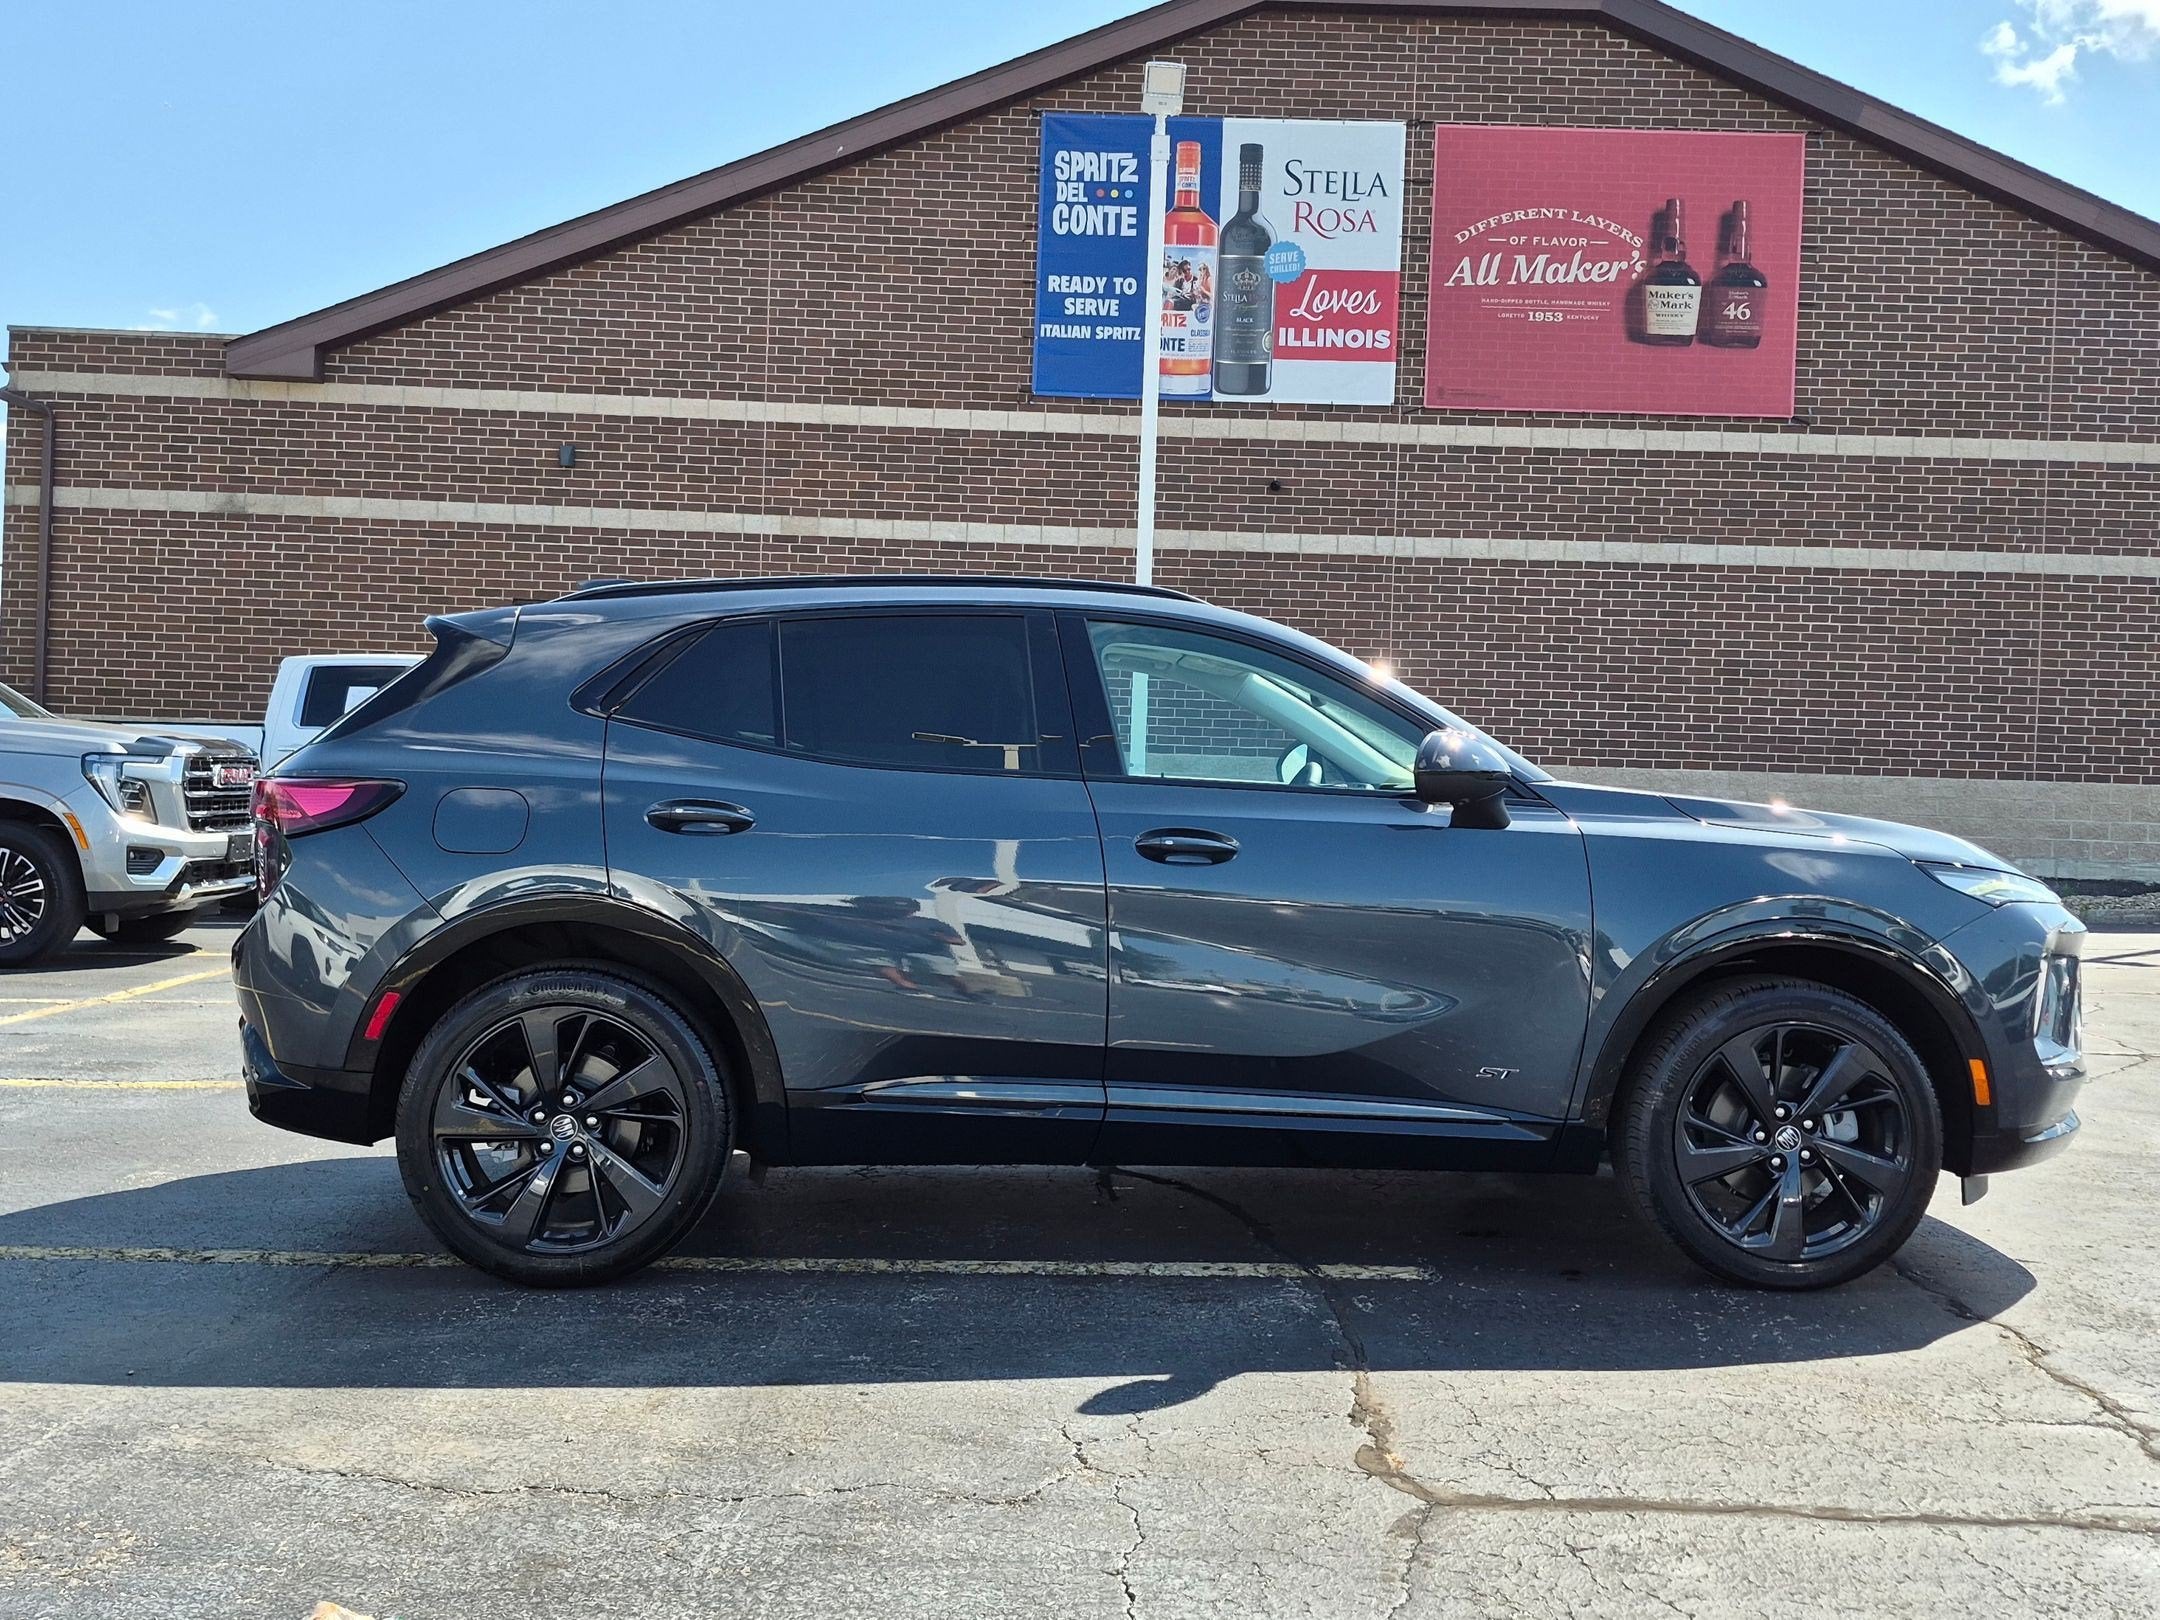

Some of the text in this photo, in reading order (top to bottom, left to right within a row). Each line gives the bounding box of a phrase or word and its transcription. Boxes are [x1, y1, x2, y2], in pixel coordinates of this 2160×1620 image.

[1054, 150, 1139, 183] SPRITZ
[1283, 159, 1389, 202] STELLA
[1056, 181, 1088, 203] DEL
[1052, 203, 1137, 237] CONTE
[1293, 200, 1378, 240] ROSA
[1454, 207, 1644, 248] DIFFERENT LAYERS
[1509, 235, 1588, 247] OF FLAVOR
[1269, 250, 1298, 265] SERVE
[1270, 262, 1300, 274] CHILLED!
[1444, 249, 1648, 287] All Maker's
[1047, 275, 1137, 295] READY TO
[1648, 290, 1694, 300] Maker's
[1064, 297, 1120, 317] SERVE
[1289, 274, 1382, 322] Loves
[1660, 300, 1693, 310] Mark
[1160, 312, 1187, 328] RITZ
[1527, 311, 1564, 322] 1953
[1722, 301, 1751, 321] 46
[1040, 323, 1092, 340] ITALIAN
[1095, 325, 1142, 341] SPRITZ
[1278, 326, 1392, 350] ILLINOIS
[1475, 1066, 1520, 1080] ST
